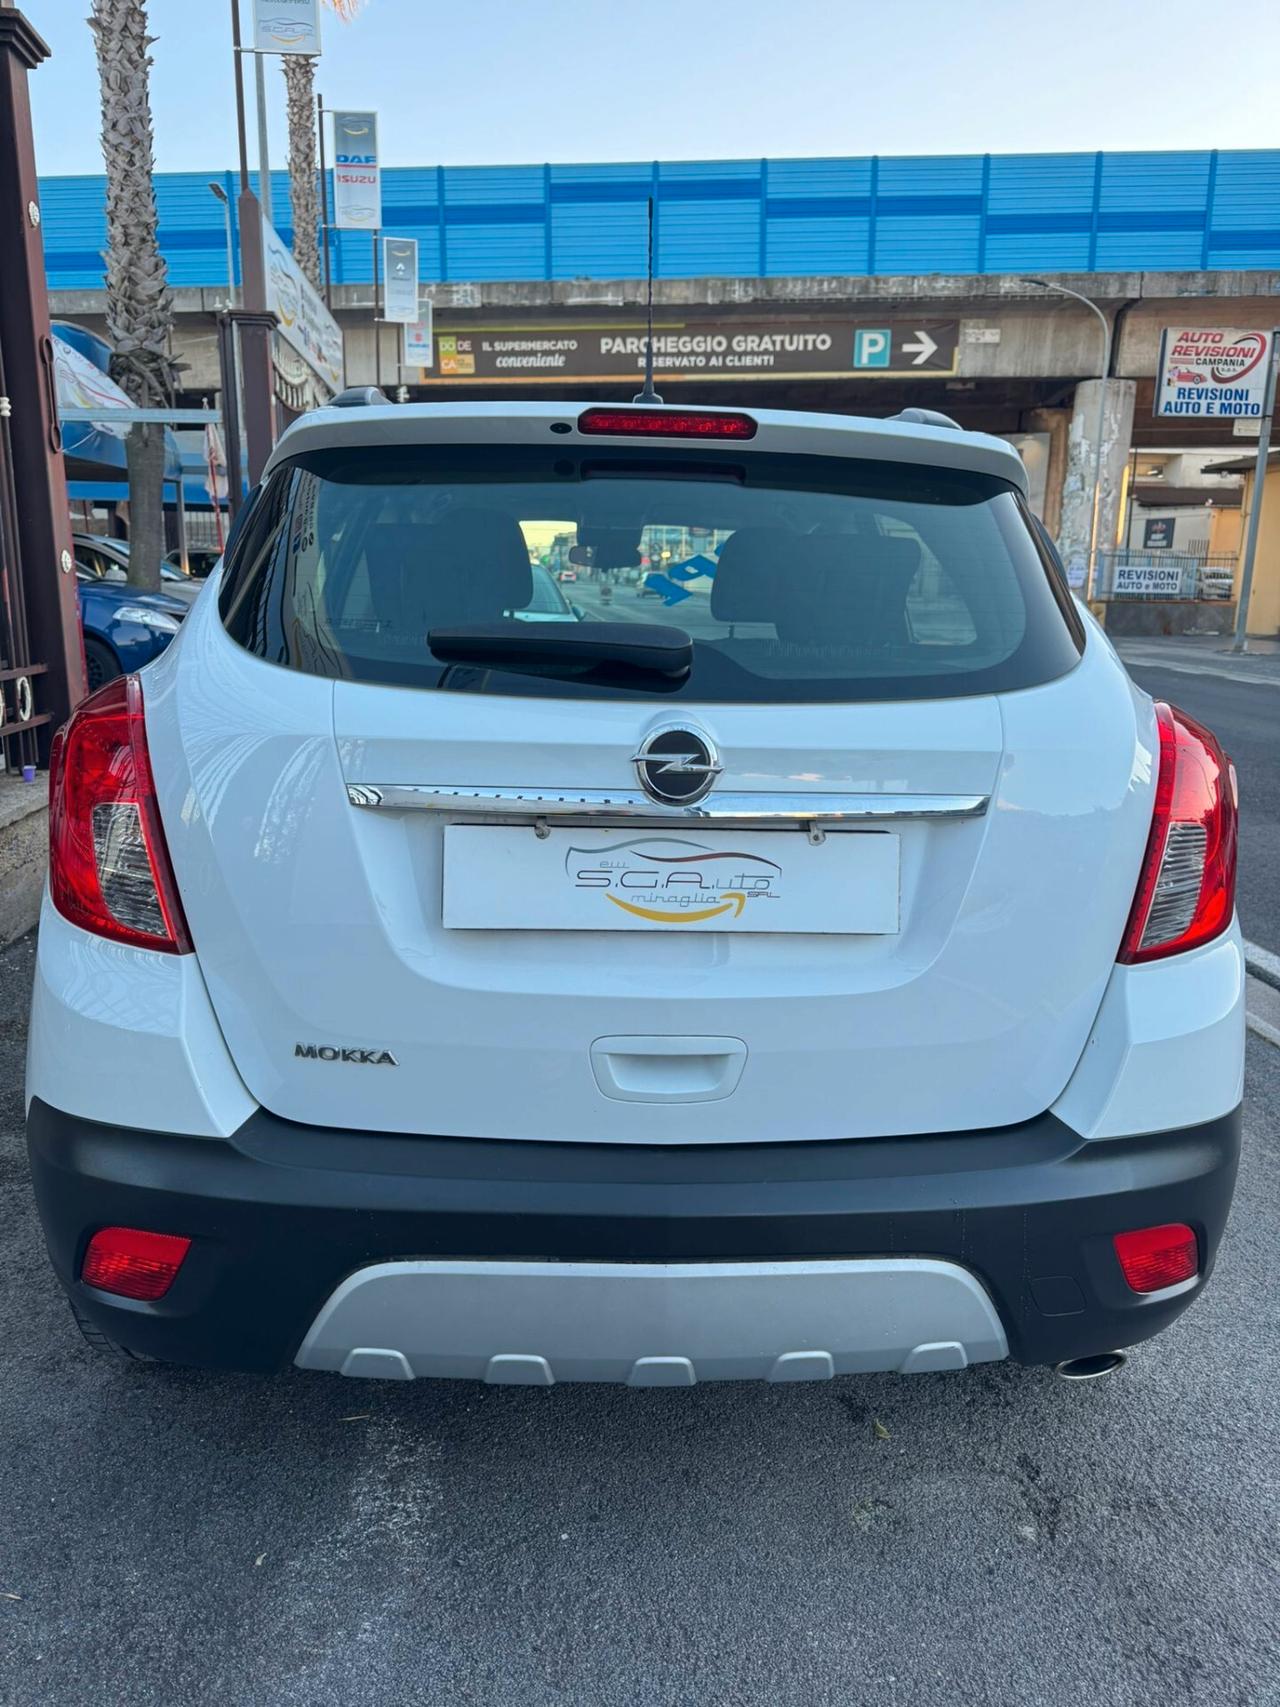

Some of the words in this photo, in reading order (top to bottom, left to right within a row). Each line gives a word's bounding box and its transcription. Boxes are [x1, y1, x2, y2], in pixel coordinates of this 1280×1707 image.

[336, 154, 377, 164] DAF
[337, 174, 376, 184] ISUZU
[600, 335, 727, 354] PARCHEGGIO
[732, 334, 832, 352] GRATUITO
[1177, 331, 1224, 344] AUTO
[482, 341, 493, 351] IL
[494, 340, 578, 351] SUPERMERCATO
[860, 333, 885, 365] P
[1171, 345, 1256, 359] REVISIONI
[496, 353, 566, 368] conveniente
[638, 355, 705, 368] RSERVATO
[709, 355, 723, 367] AI
[726, 354, 774, 367] CLIENTI
[1195, 358, 1245, 367] CAMPANIA
[1177, 387, 1250, 401] REVISIONI
[1163, 401, 1201, 414] AUTO
[1206, 402, 1215, 414] E
[1219, 402, 1260, 415] MOTO
[1118, 569, 1179, 581] REVISIONI
[1116, 582, 1142, 590] AUTO
[1153, 582, 1178, 591] MOTO
[295, 1042, 400, 1066] MOKKA
